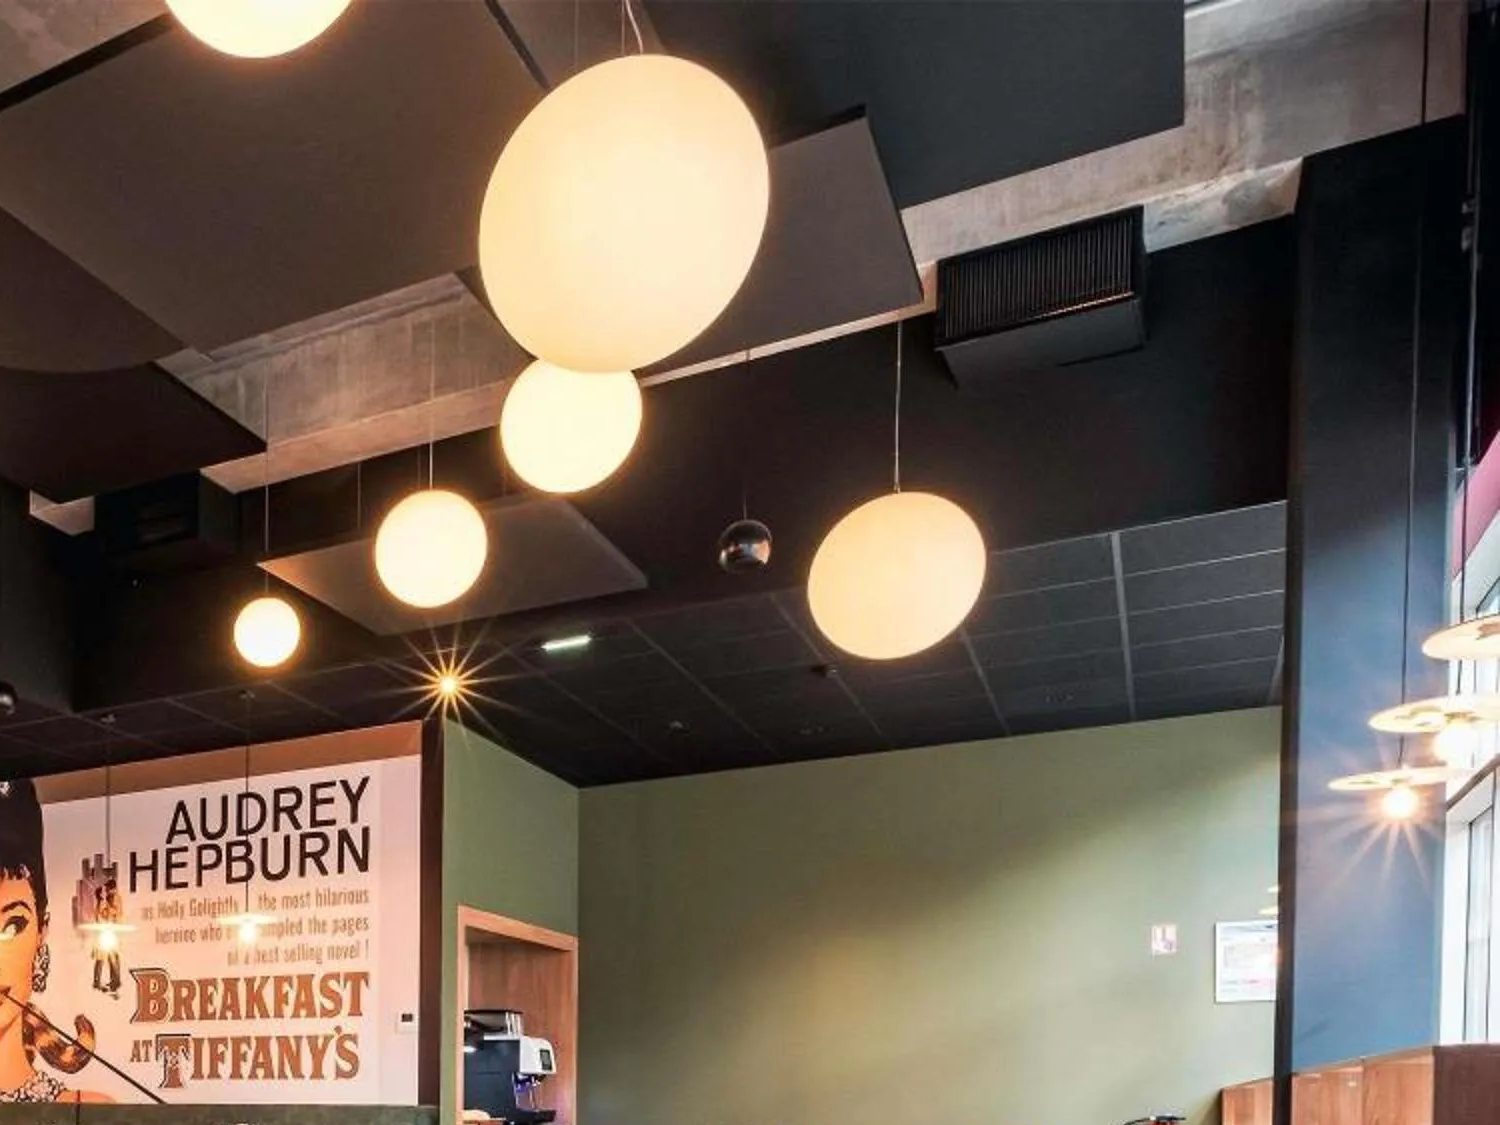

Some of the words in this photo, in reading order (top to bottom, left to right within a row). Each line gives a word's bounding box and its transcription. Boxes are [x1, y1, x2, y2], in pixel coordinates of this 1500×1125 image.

[165, 776, 370, 845] AUDREY
[129, 827, 370, 893] HEPBURN
[157, 899, 184, 920] Holly
[258, 892, 276, 911] the
[282, 892, 311, 909] most
[315, 888, 370, 908] hilarious
[200, 922, 222, 941] who
[308, 915, 327, 934] the
[332, 916, 369, 936] pages
[284, 943, 323, 964] selling
[129, 967, 370, 1024] BREAKFAST
[130, 1038, 153, 1064] AT
[155, 1025, 360, 1088] TIFFANY'S
